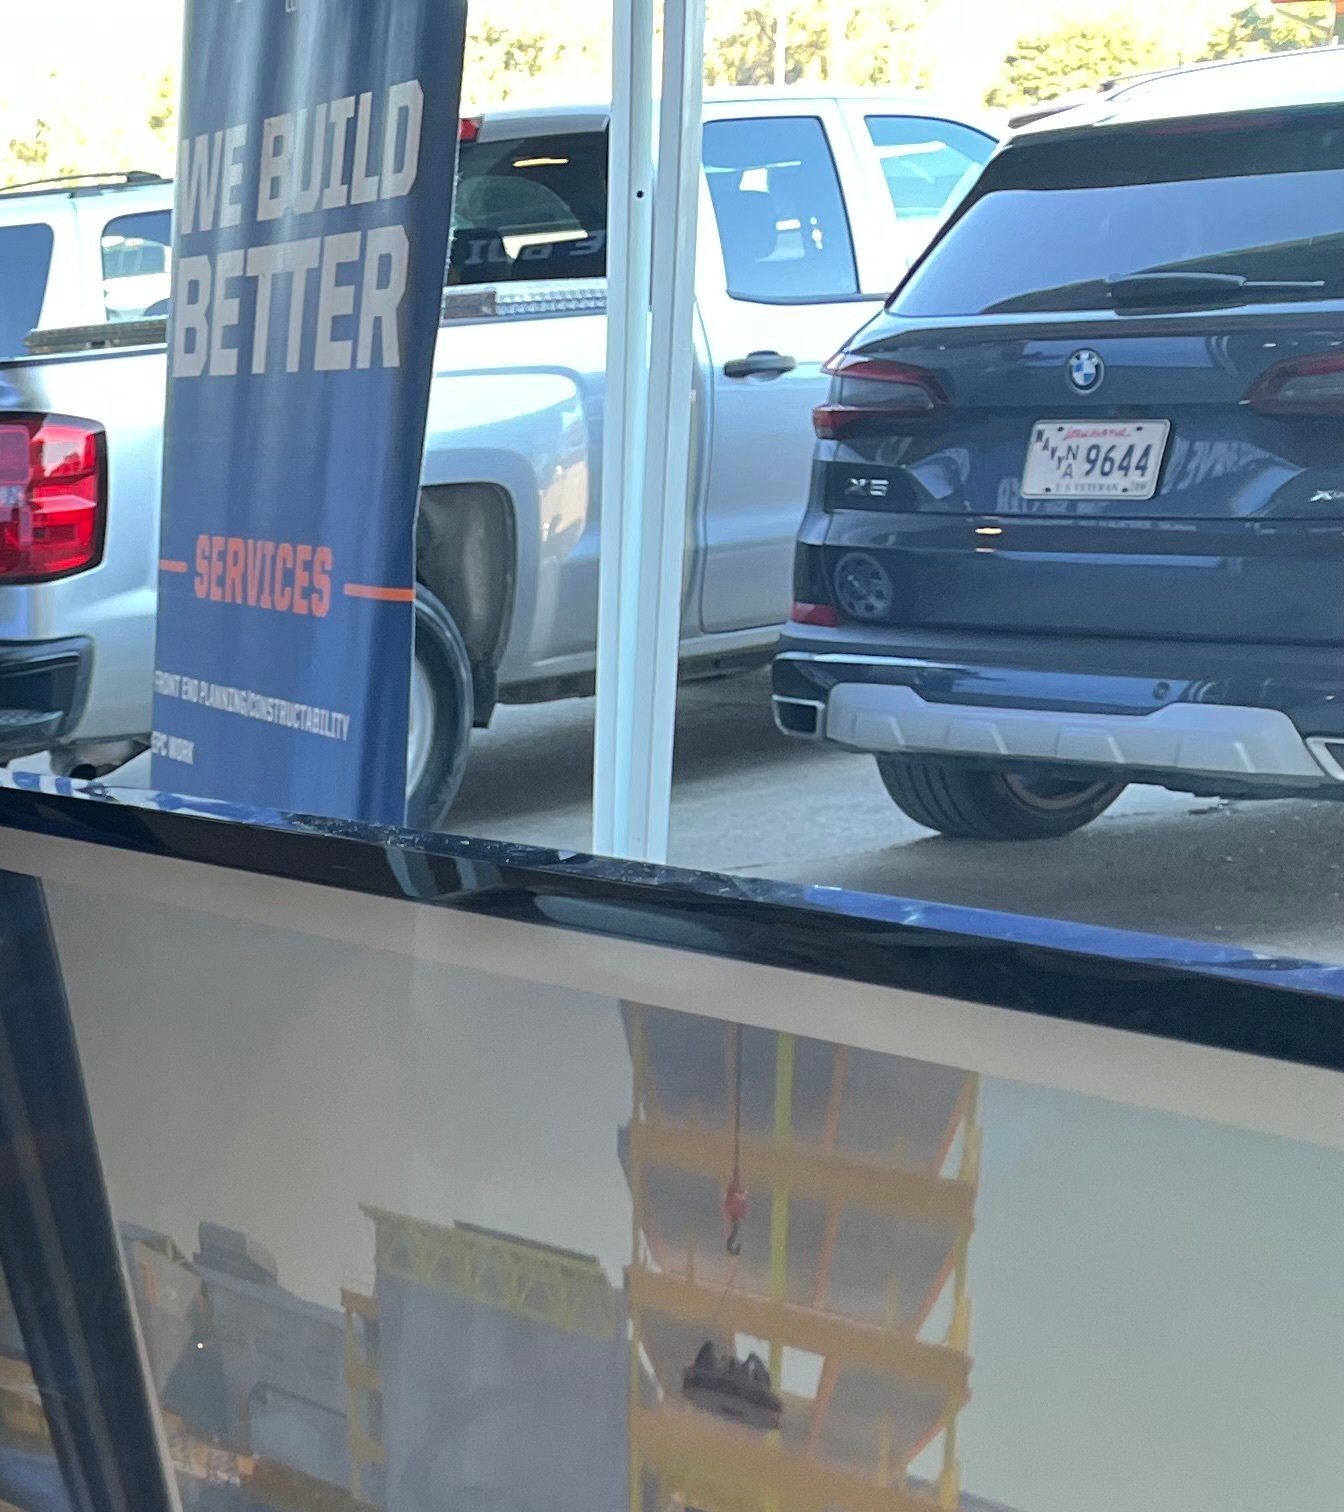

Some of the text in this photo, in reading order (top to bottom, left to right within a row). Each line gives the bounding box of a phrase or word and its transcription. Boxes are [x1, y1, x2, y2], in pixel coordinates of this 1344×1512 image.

[180, 79, 425, 235] WE BUILD
[172, 224, 411, 378] BETTER
[1084, 443, 1153, 478] 9644
[194, 534, 334, 618] SERVICES
